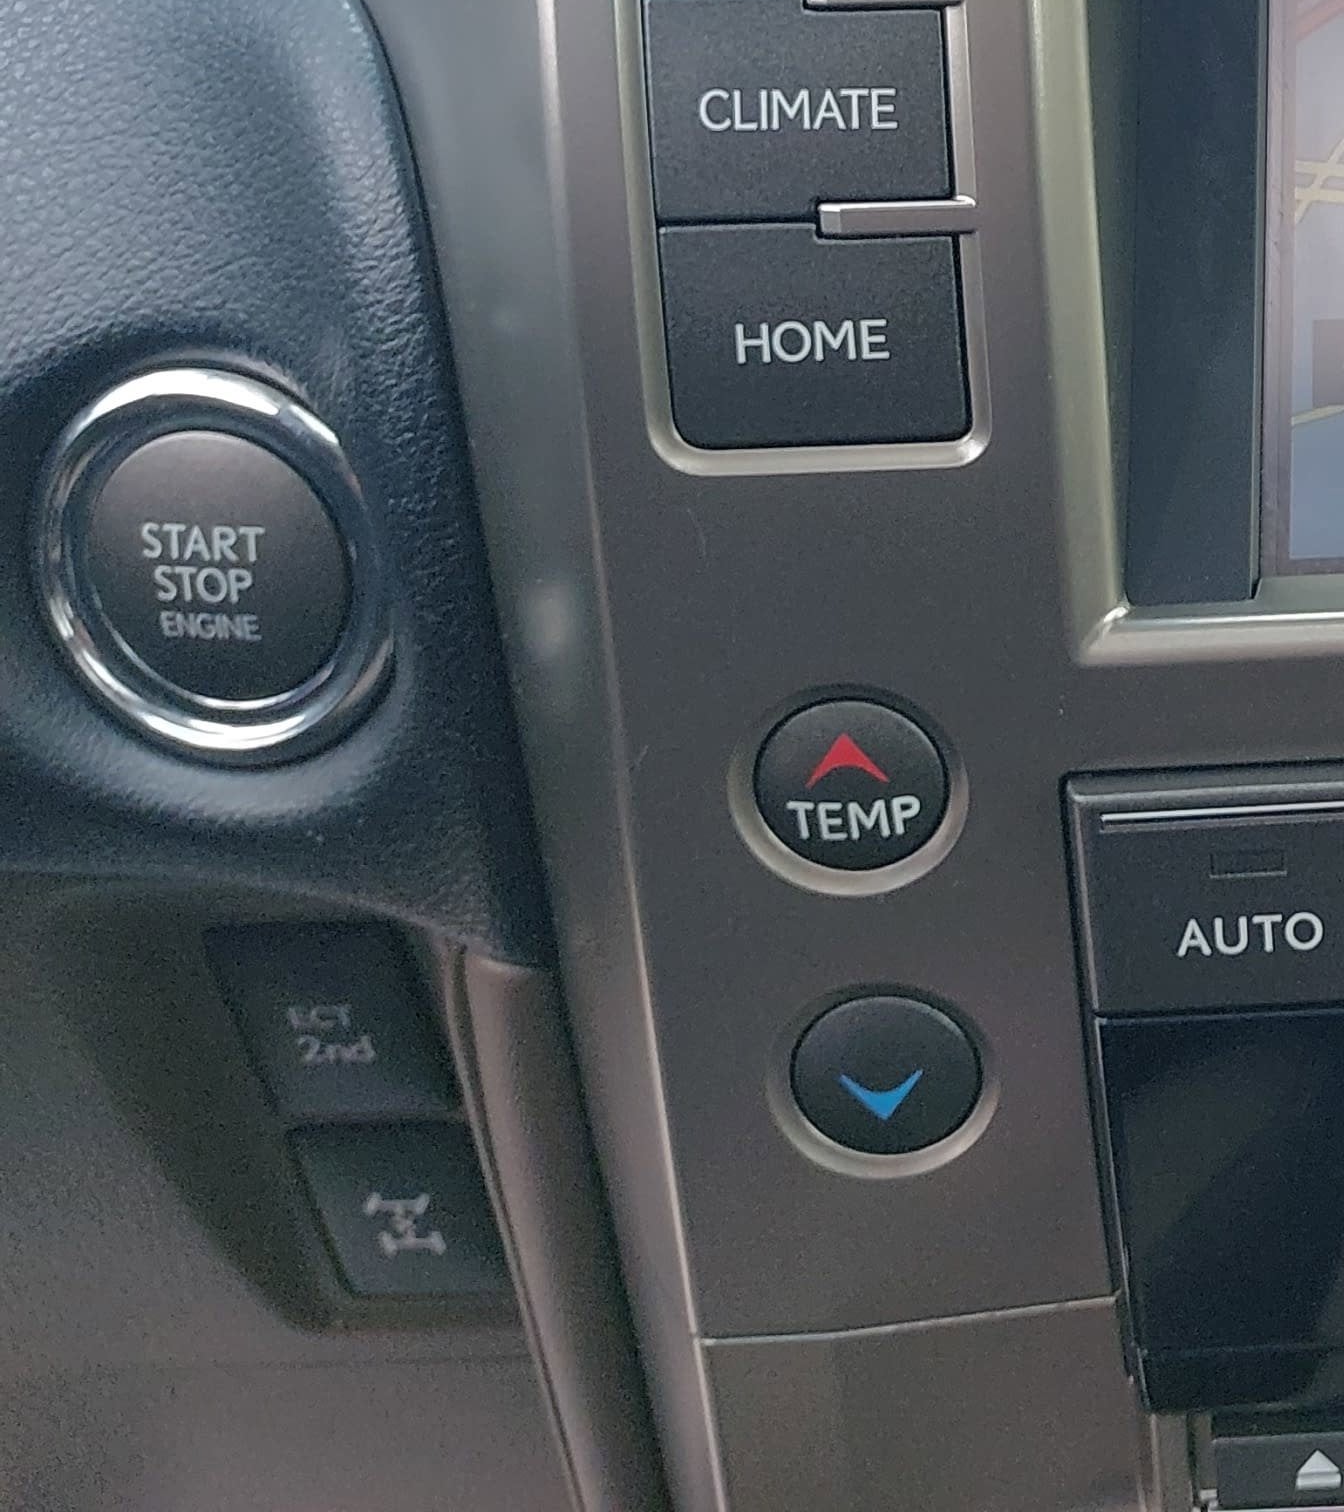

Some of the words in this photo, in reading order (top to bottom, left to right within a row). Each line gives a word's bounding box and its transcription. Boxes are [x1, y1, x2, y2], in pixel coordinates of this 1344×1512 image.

[699, 87, 899, 132] CLIMATE
[733, 318, 891, 365] HOME
[140, 521, 266, 563] START
[153, 564, 254, 605] STOP
[158, 610, 263, 642] ENGINE
[786, 794, 922, 842] TEMP
[1175, 912, 1325, 958] AUTO
